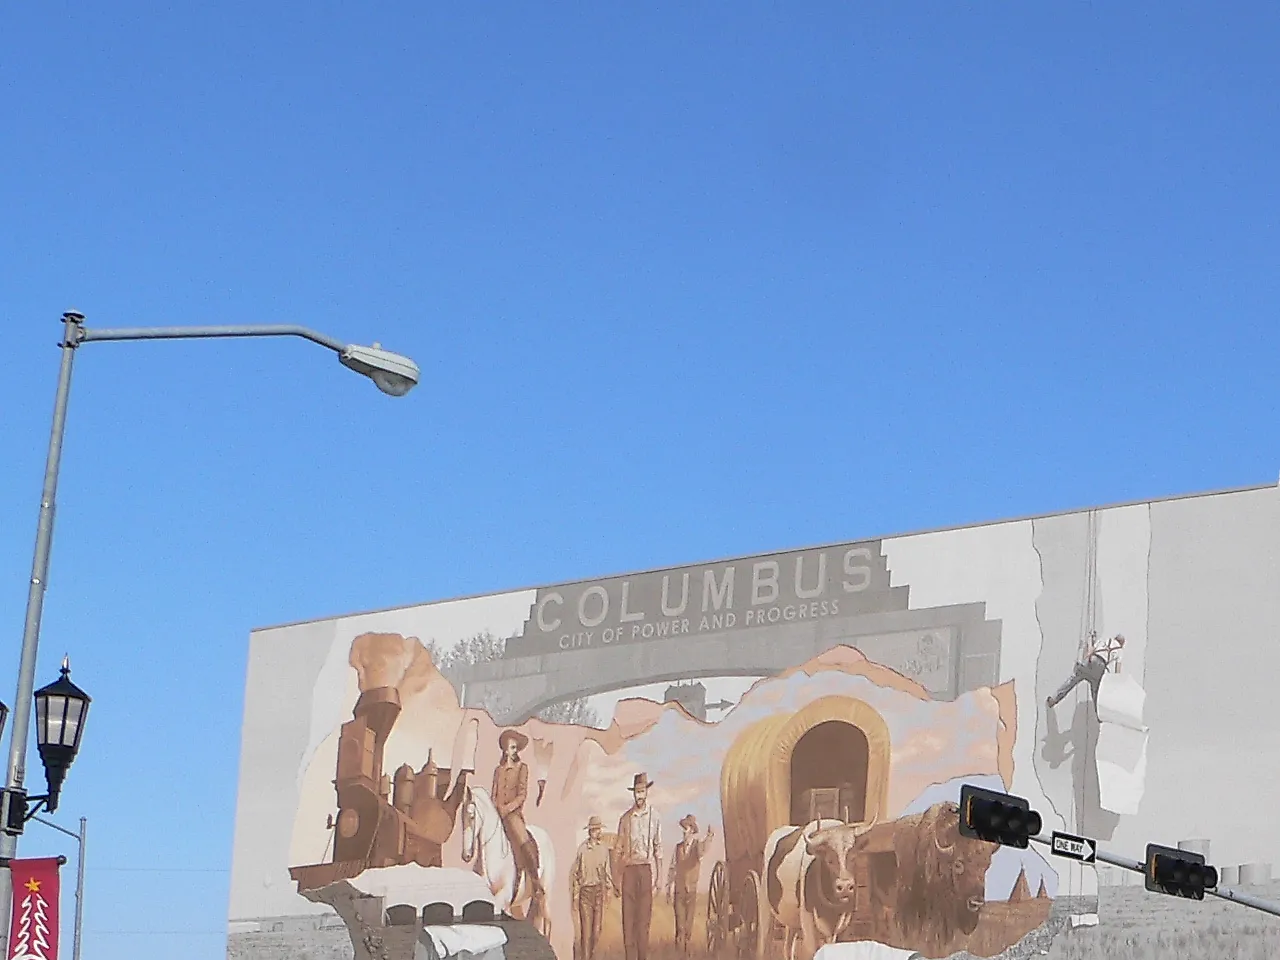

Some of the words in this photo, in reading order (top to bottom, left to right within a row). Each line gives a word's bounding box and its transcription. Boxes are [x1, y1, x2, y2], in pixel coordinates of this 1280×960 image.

[537, 546, 873, 632] COLUMBUS
[559, 631, 594, 649] CITY
[602, 627, 624, 643] OF
[632, 618, 690, 640] POWER
[699, 612, 737, 631] AND
[745, 599, 840, 626] PROGRESS
[1055, 839, 1069, 851] ONE
[1070, 842, 1083, 854] WAY
